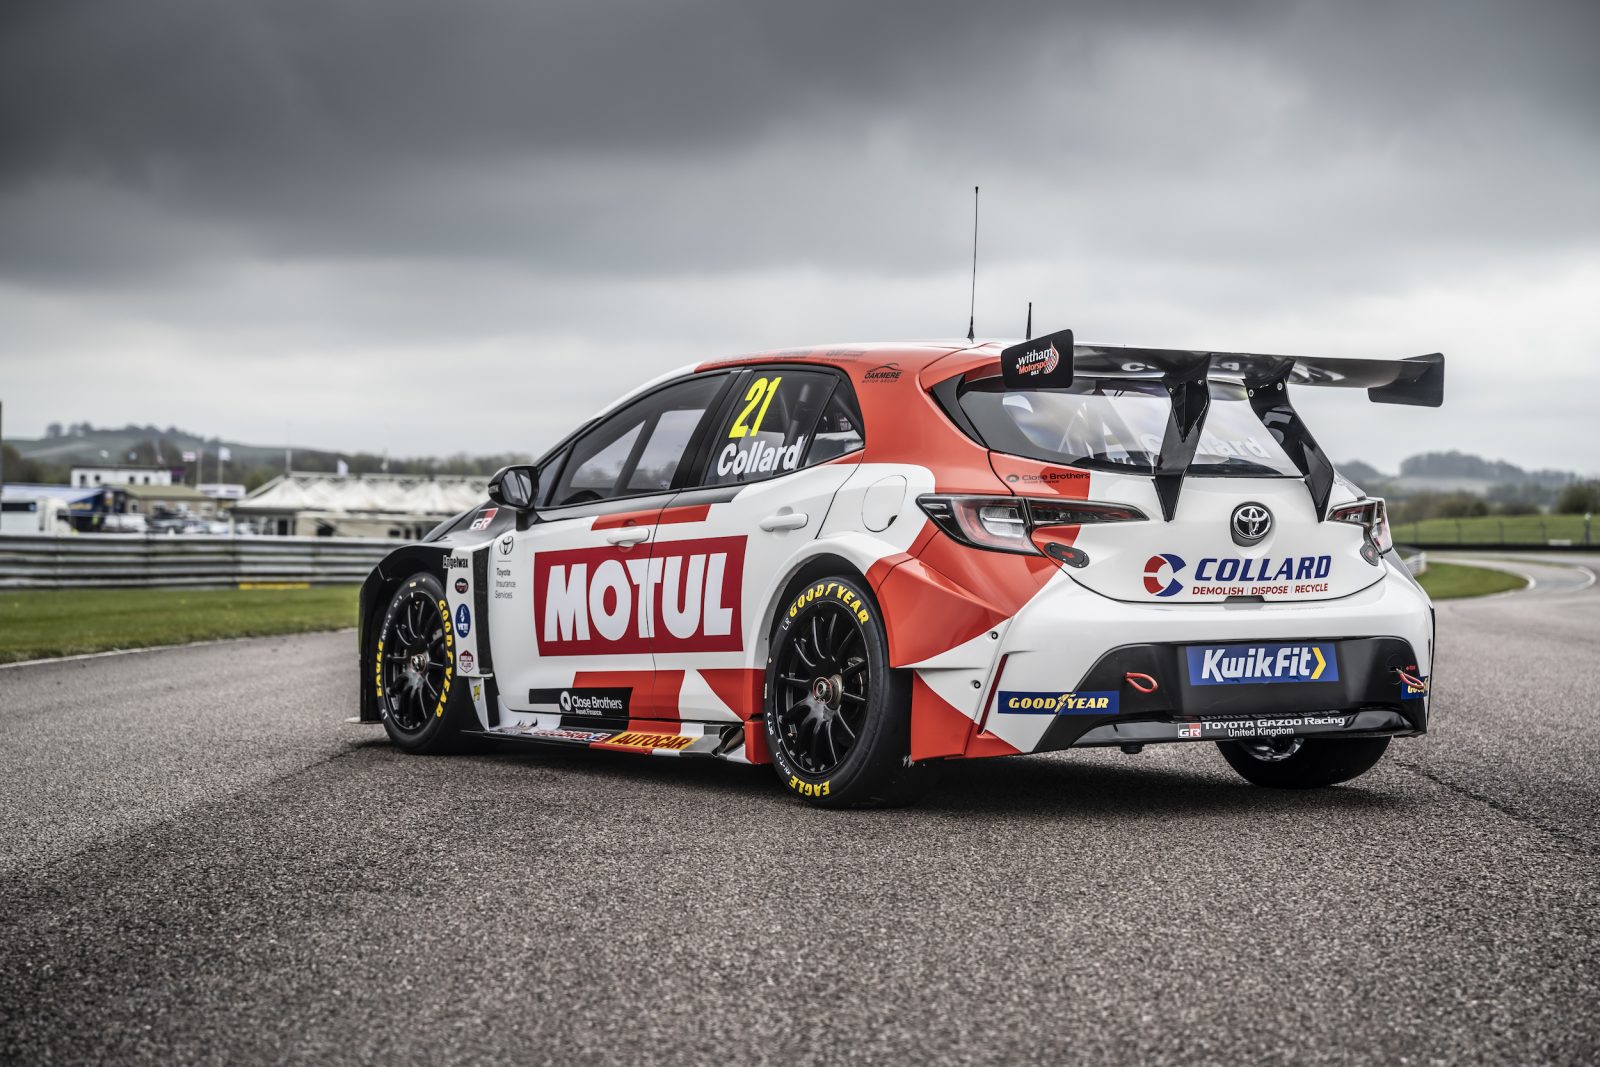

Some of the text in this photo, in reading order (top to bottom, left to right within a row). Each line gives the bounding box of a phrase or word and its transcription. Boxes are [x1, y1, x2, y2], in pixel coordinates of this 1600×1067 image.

[1018, 349, 1053, 366] witham
[864, 371, 901, 379] OAKMERE
[728, 377, 782, 439] 21
[717, 434, 803, 476] Collard
[1050, 472, 1091, 480] Brothers
[442, 554, 469, 569] Angelwax
[1194, 555, 1332, 582] COLLARD
[496, 568, 511, 576] Toyota
[495, 591, 513, 599] Services
[1192, 583, 1329, 595] DEMOLISH DISPOSE RECYCLE
[544, 552, 733, 642] MOTUL
[571, 695, 623, 709] Close Brothers
[1179, 716, 1345, 737] GR TOYOTA GAZOO Racing
[1228, 726, 1294, 738] United Kingdom
[611, 733, 693, 749] AUTOCAR
[789, 775, 830, 797] EAGLE
